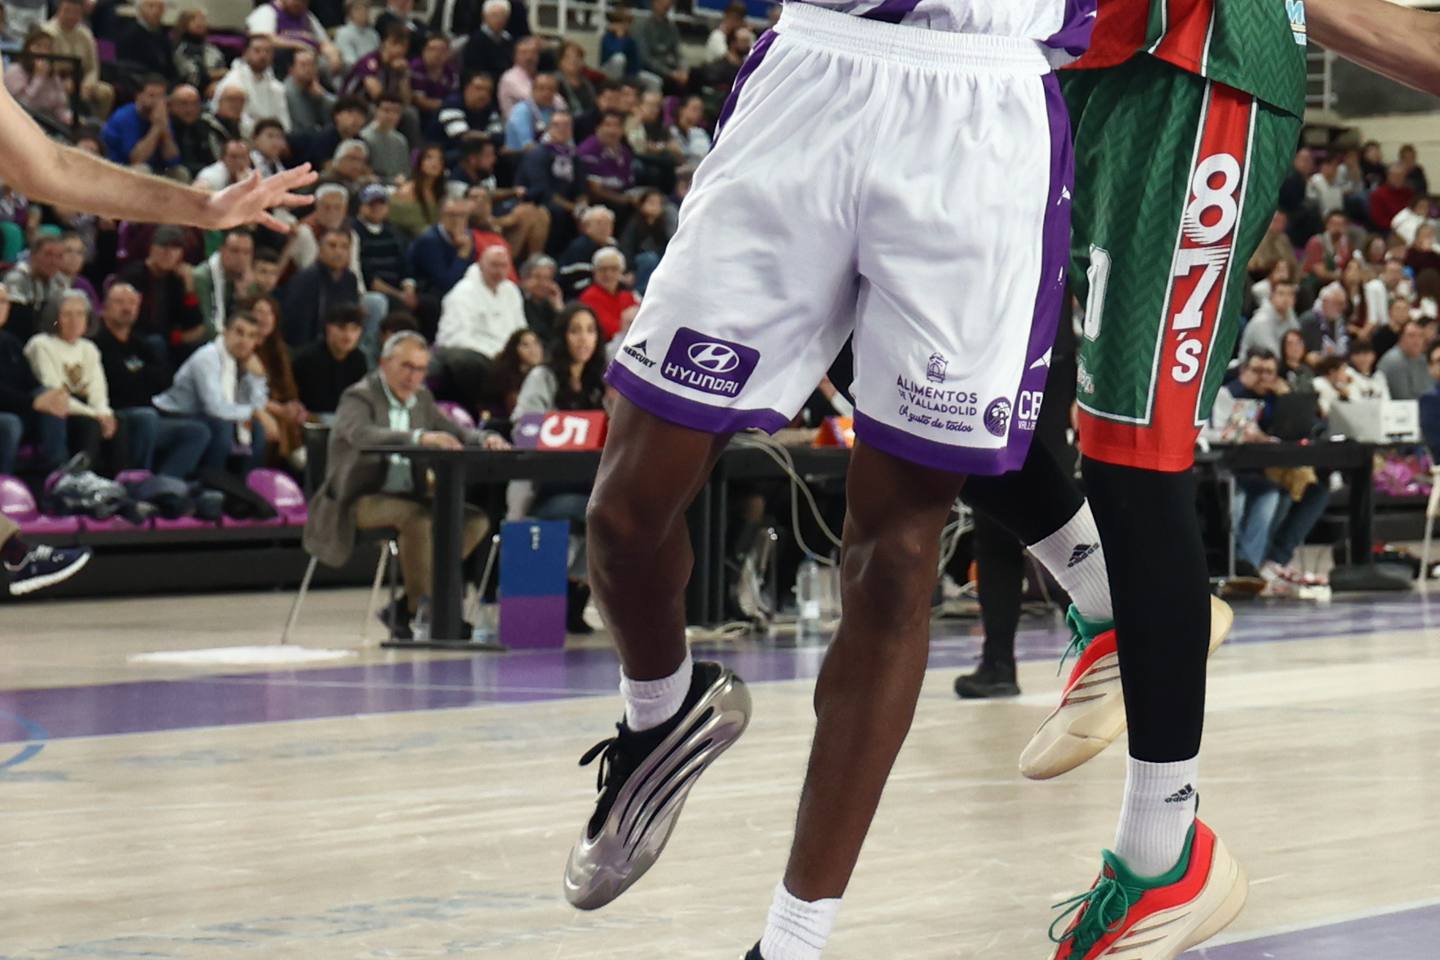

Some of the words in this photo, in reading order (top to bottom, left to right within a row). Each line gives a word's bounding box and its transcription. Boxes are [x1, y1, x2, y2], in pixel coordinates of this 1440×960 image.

[623, 345, 657, 369] MERCURY
[665, 361, 739, 394] HYUNDAI
[897, 375, 978, 405] ALIMENTOS
[908, 392, 978, 417] VALLADOLID
